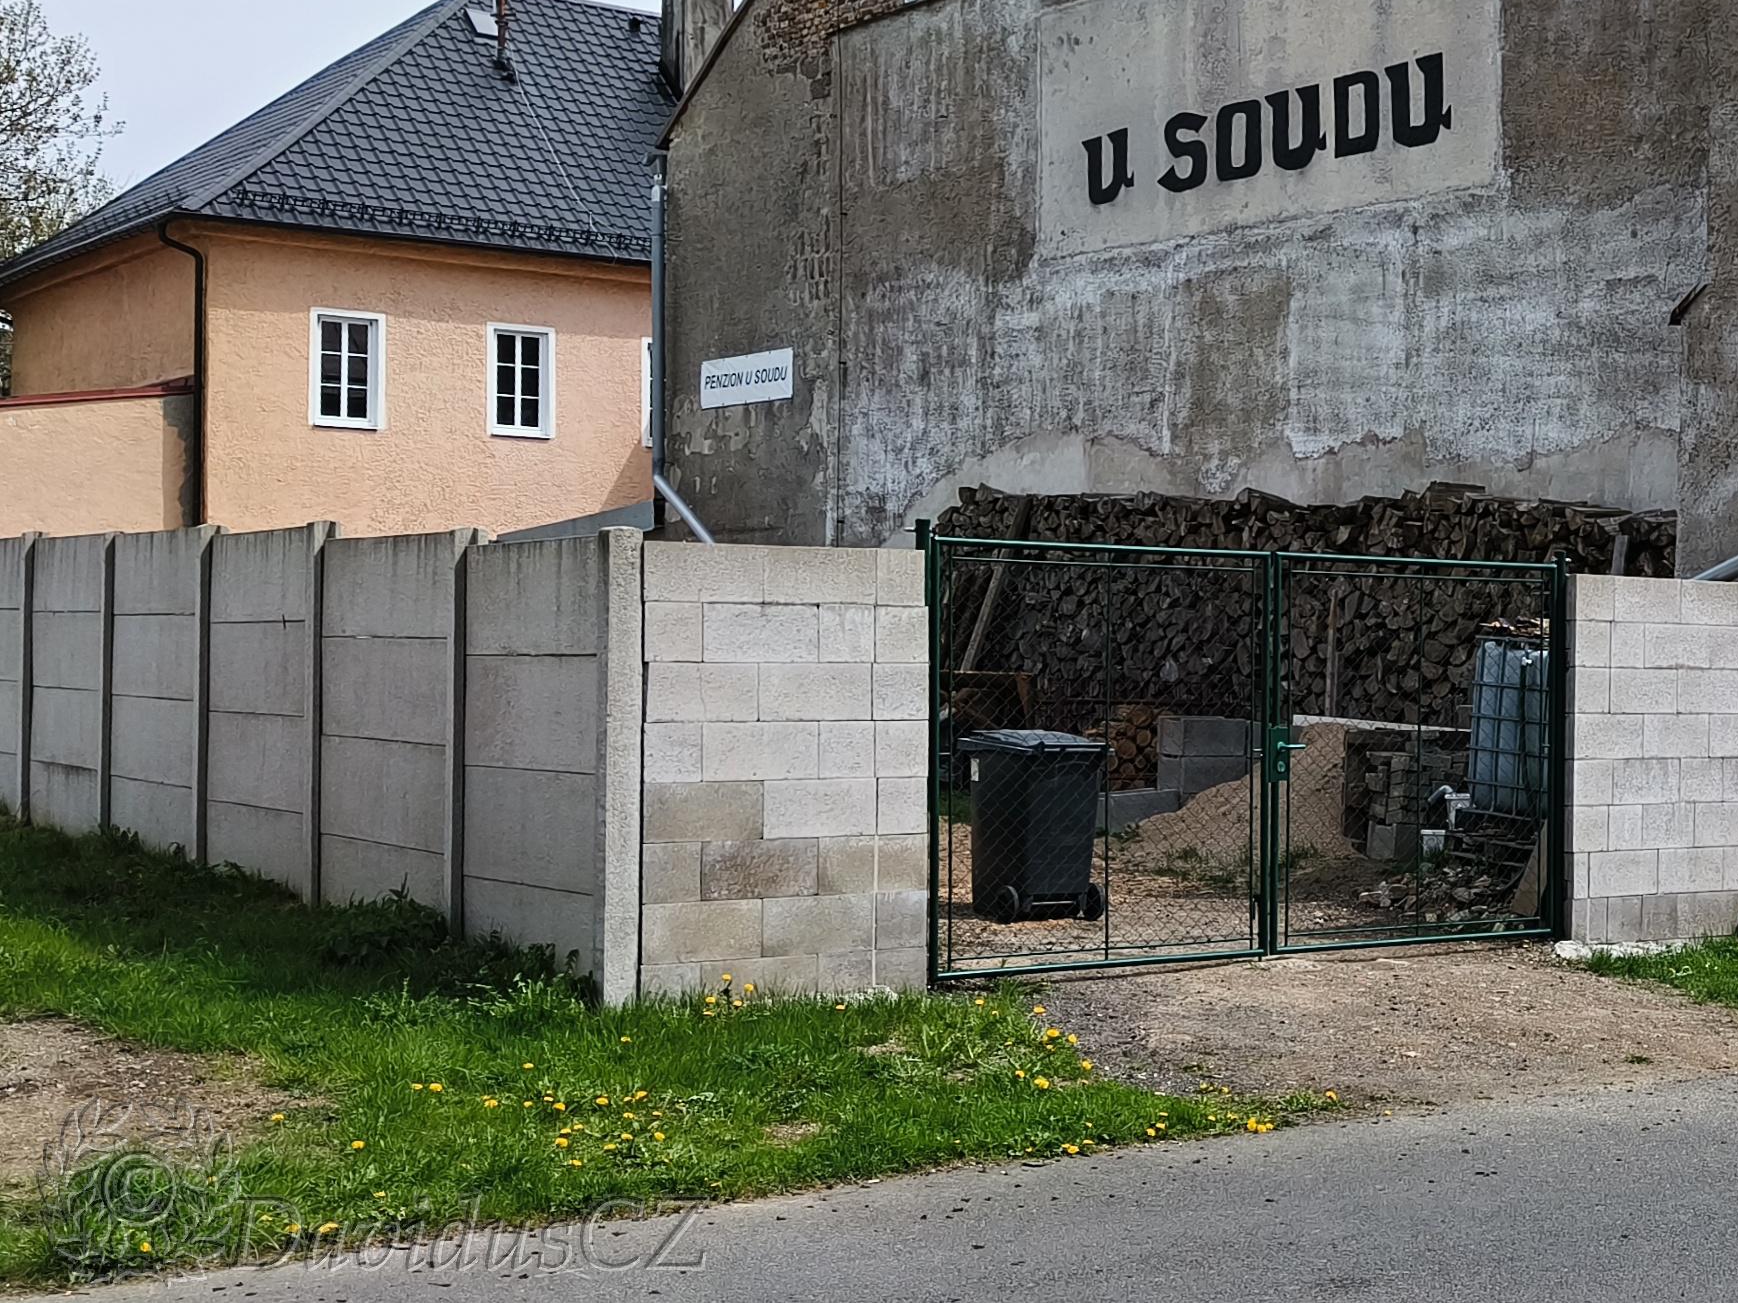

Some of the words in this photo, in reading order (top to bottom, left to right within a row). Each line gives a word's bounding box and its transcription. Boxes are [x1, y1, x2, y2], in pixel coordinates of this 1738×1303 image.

[1157, 52, 1452, 194] SOUDU
[704, 372, 743, 390] PENZION
[745, 371, 753, 386] U
[754, 366, 788, 385] SOUDU
